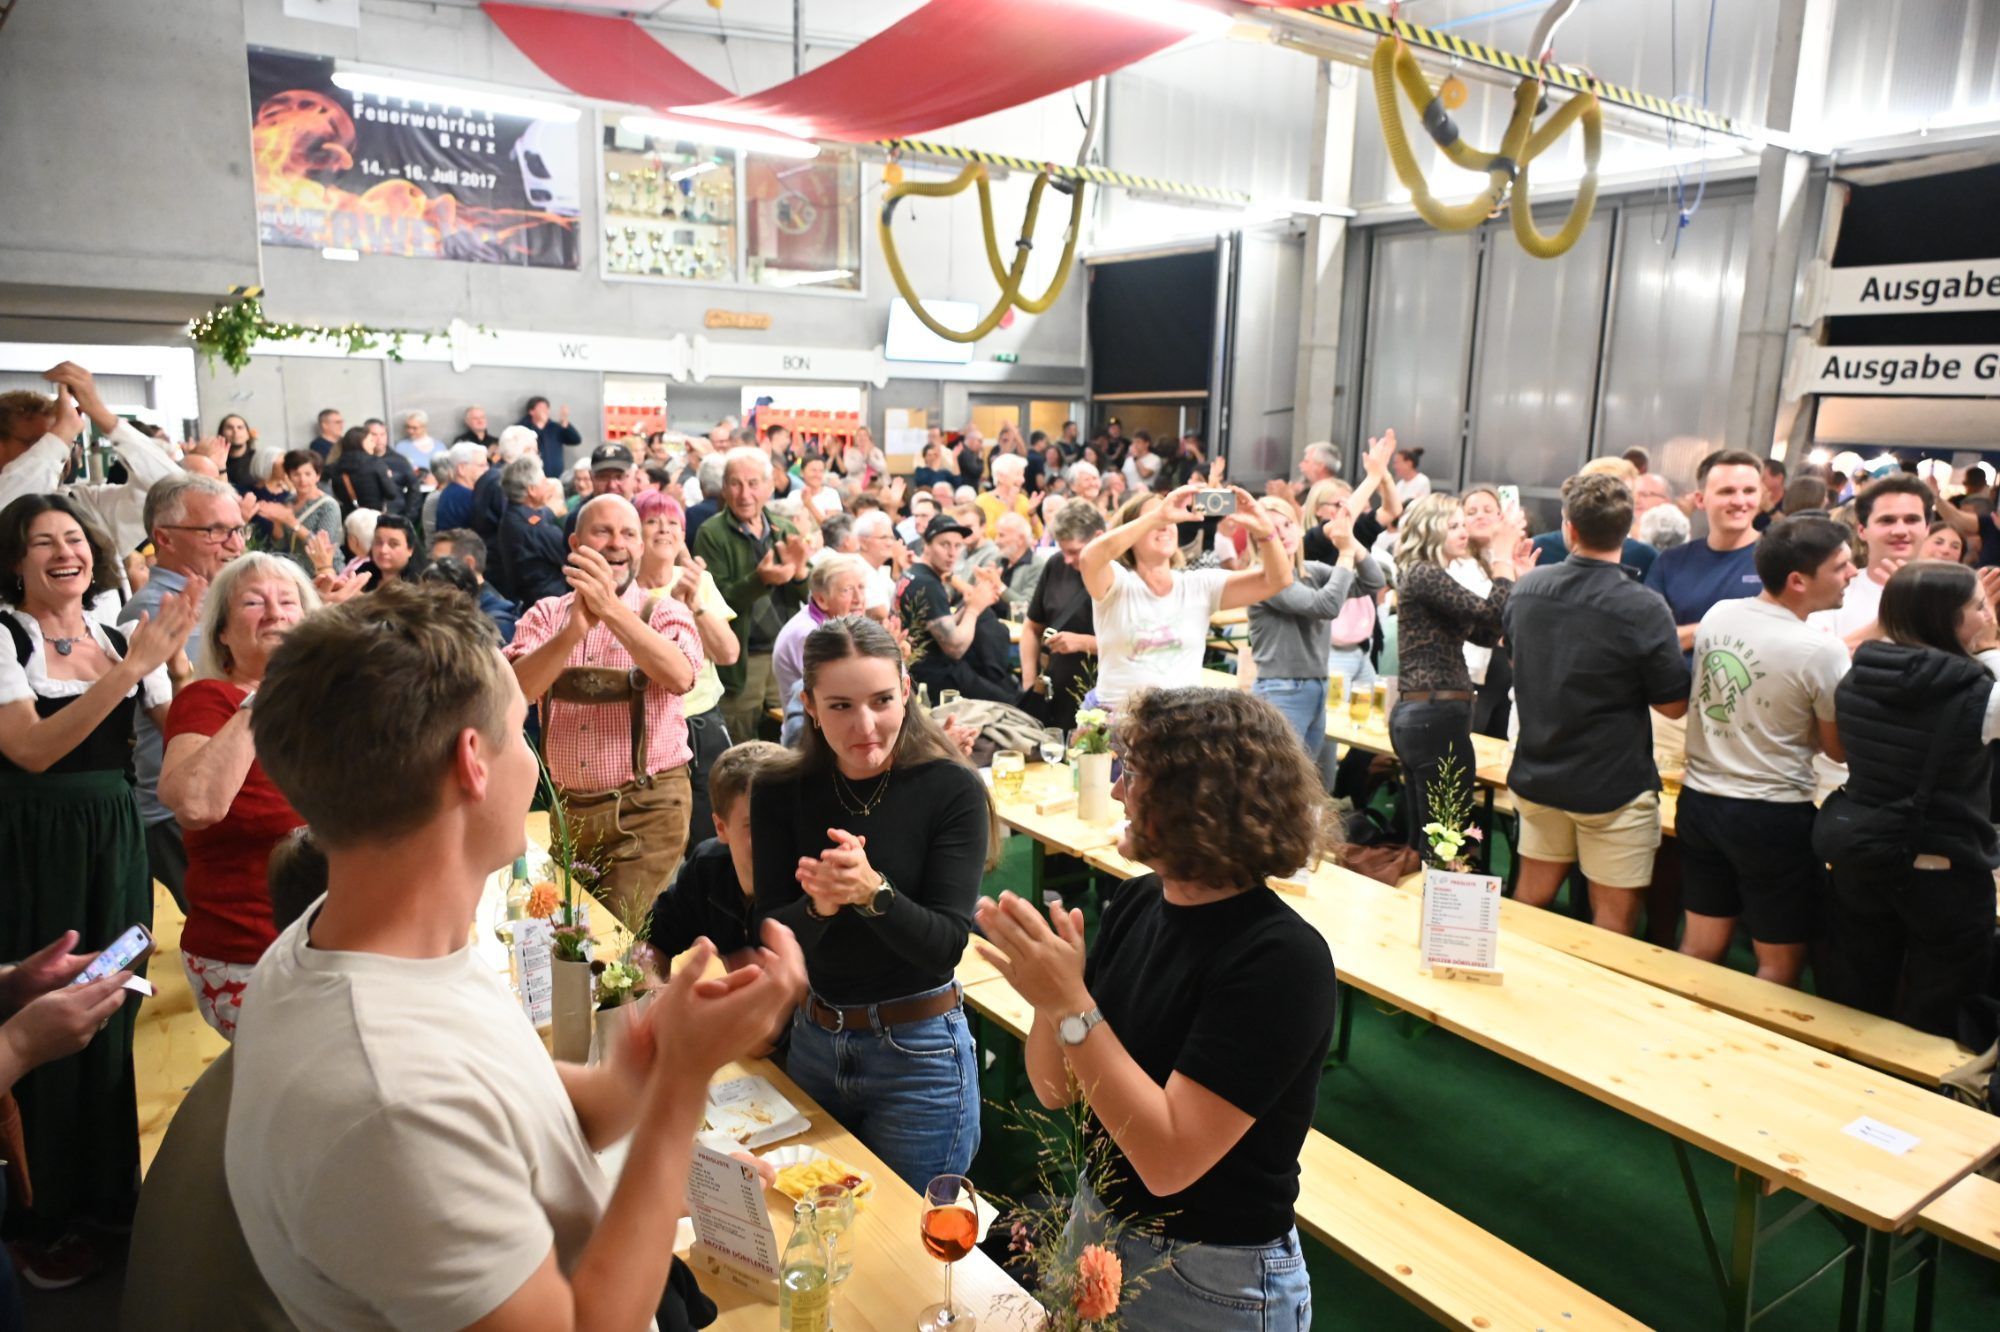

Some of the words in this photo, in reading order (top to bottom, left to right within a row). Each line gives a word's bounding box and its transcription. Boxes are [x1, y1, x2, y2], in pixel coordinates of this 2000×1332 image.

[353, 103, 496, 137] Feuerwehrfest
[439, 133, 496, 154] Braz
[360, 158, 385, 176] 14.
[430, 167, 458, 184] Juli
[460, 172, 497, 189] 2017
[1859, 270, 2000, 306] Ausgabe
[558, 342, 589, 360] WC
[782, 355, 811, 370] BON
[1821, 353, 1961, 386] Ausgabe
[1974, 353, 2000, 380] G
[1697, 634, 1767, 681] COLUMBIA
